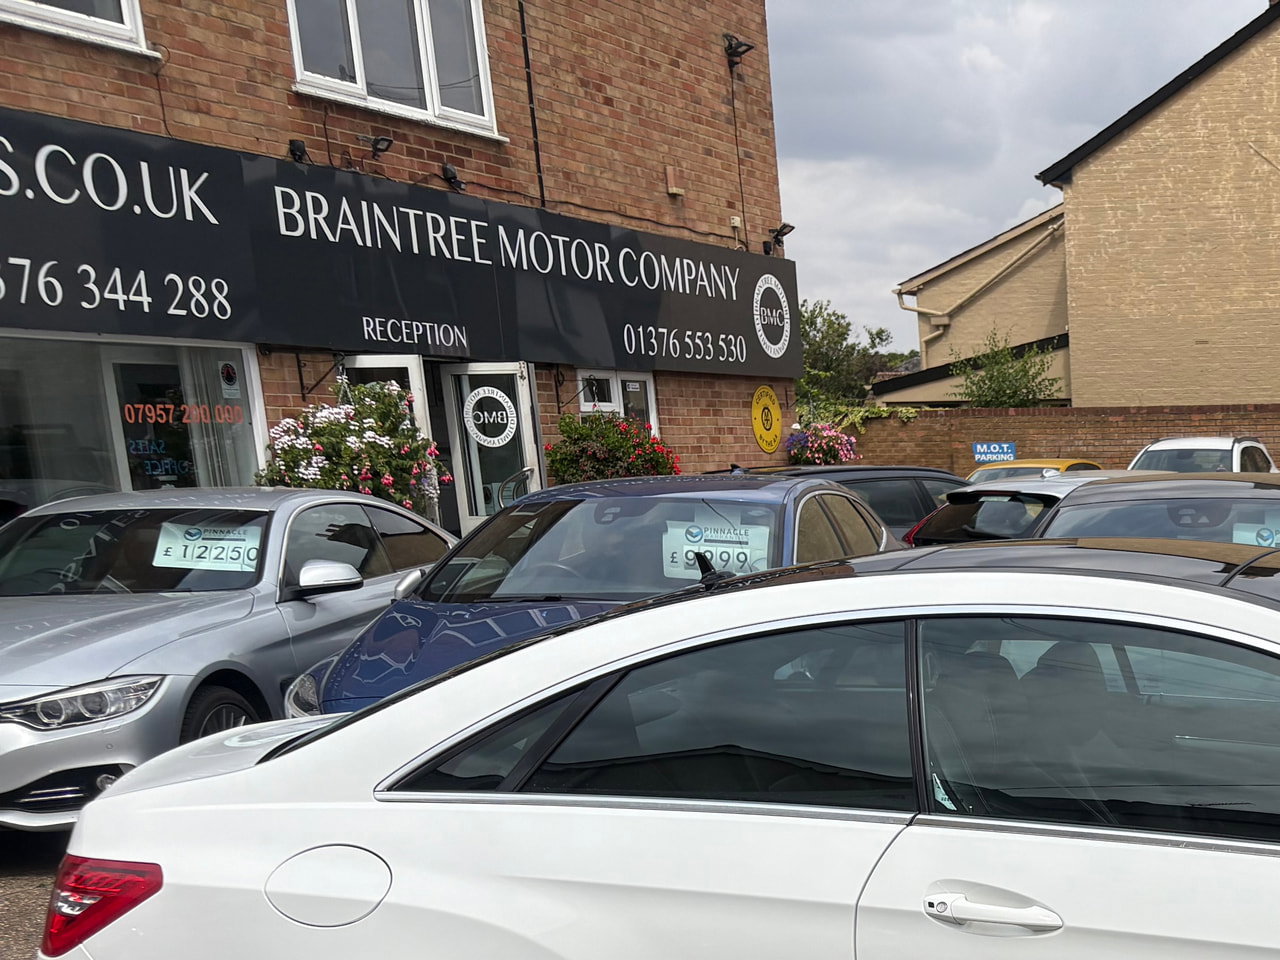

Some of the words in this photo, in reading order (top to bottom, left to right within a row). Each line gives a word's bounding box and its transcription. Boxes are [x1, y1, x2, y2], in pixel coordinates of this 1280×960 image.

[274, 185, 492, 265] BRAINTREE
[498, 225, 614, 283] MOTOR
[618, 247, 740, 301] COMPANY
[0, 257, 63, 306] 76
[77, 264, 152, 313] 344
[164, 273, 232, 320] 288
[760, 307, 785, 326] BMC
[362, 316, 468, 348] RECEPTION
[624, 323, 680, 358] 01376
[684, 330, 714, 360] 553
[718, 333, 746, 363] 530
[124, 404, 175, 424] 07957
[181, 404, 211, 424] 200
[976, 444, 1012, 453] M.O.T.
[203, 528, 249, 537] PINNACLE
[703, 526, 750, 537] PINNACLE
